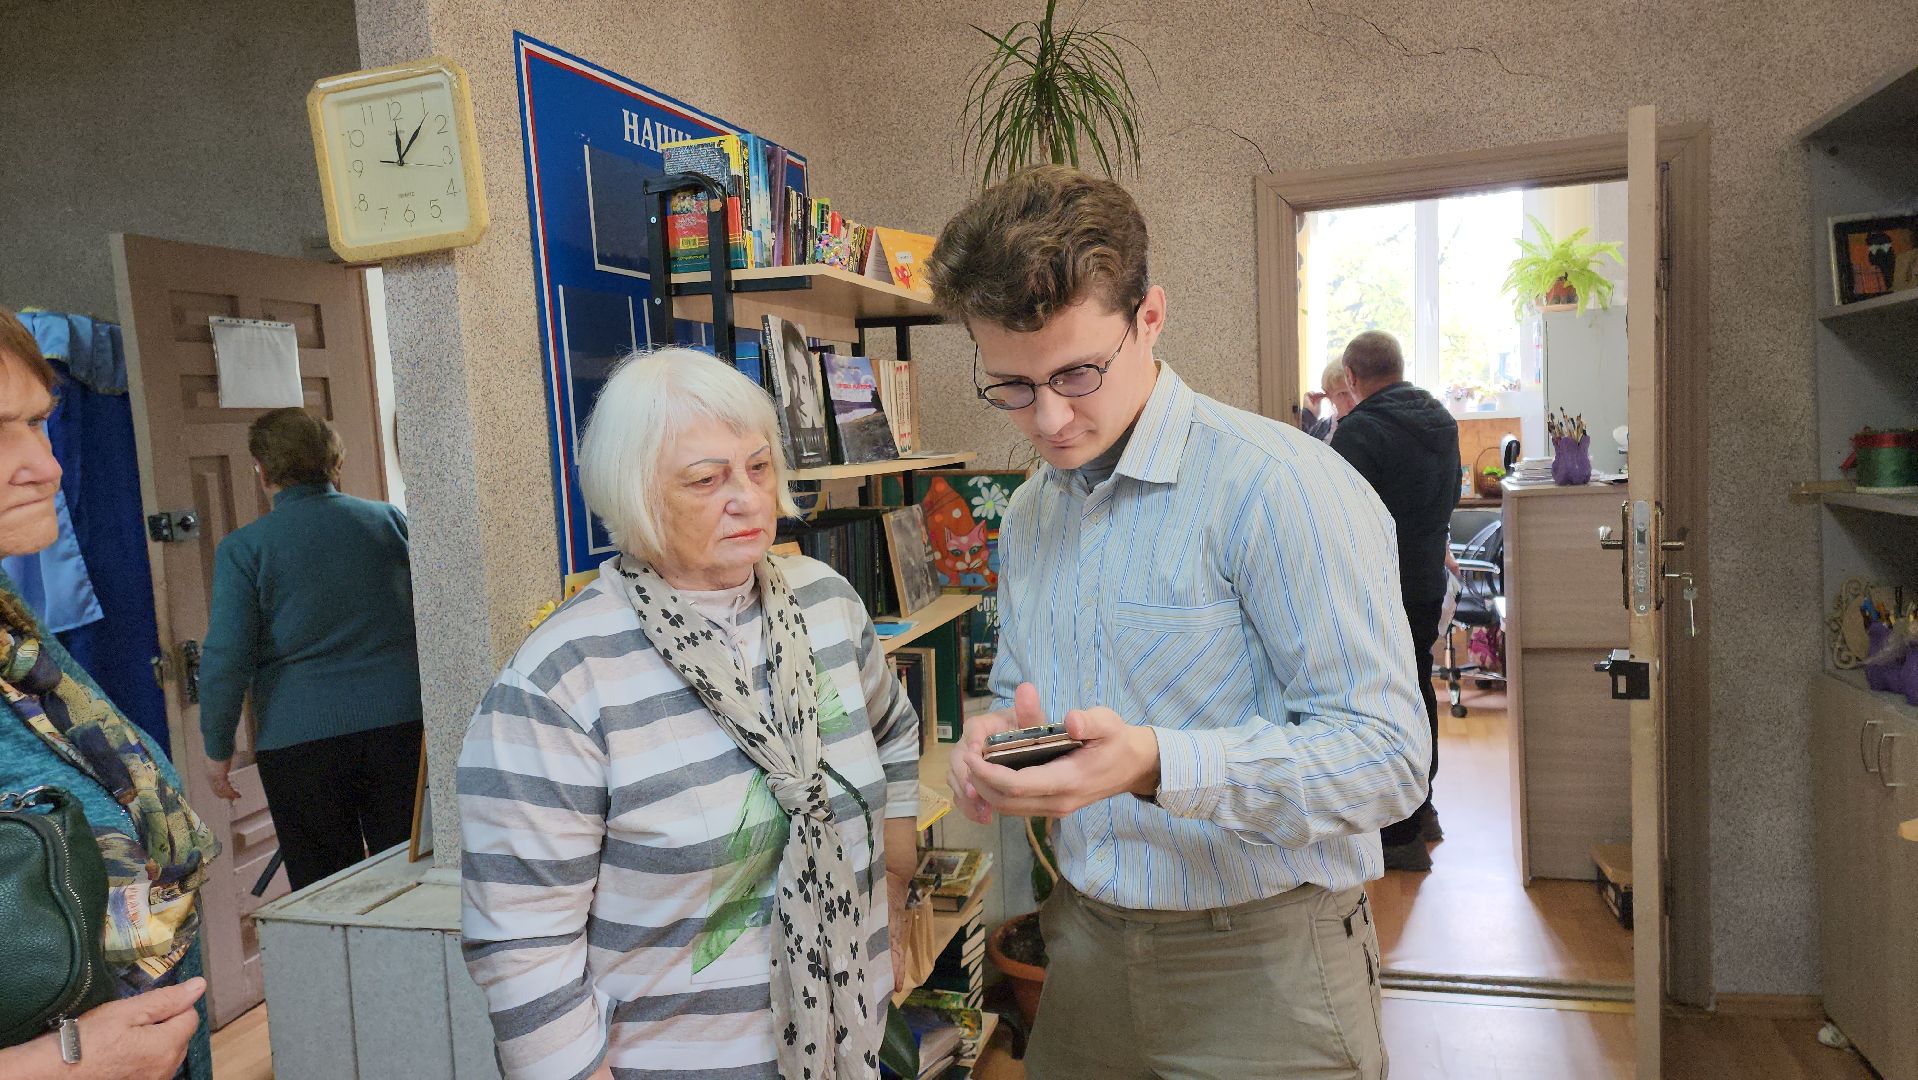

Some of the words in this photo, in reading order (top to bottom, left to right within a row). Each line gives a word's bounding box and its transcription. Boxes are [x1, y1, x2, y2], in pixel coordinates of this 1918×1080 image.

[360, 103, 375, 126] 11
[386, 101, 404, 121] 12
[434, 114, 448, 135] 2
[622, 108, 692, 153] НАШ
[442, 145, 454, 165] 3
[352, 159, 364, 178] 9
[446, 177, 458, 197] 4
[358, 193, 369, 212] 8
[429, 199, 442, 219] 5
[378, 206, 389, 227] 7
[403, 203, 416, 223] 6
